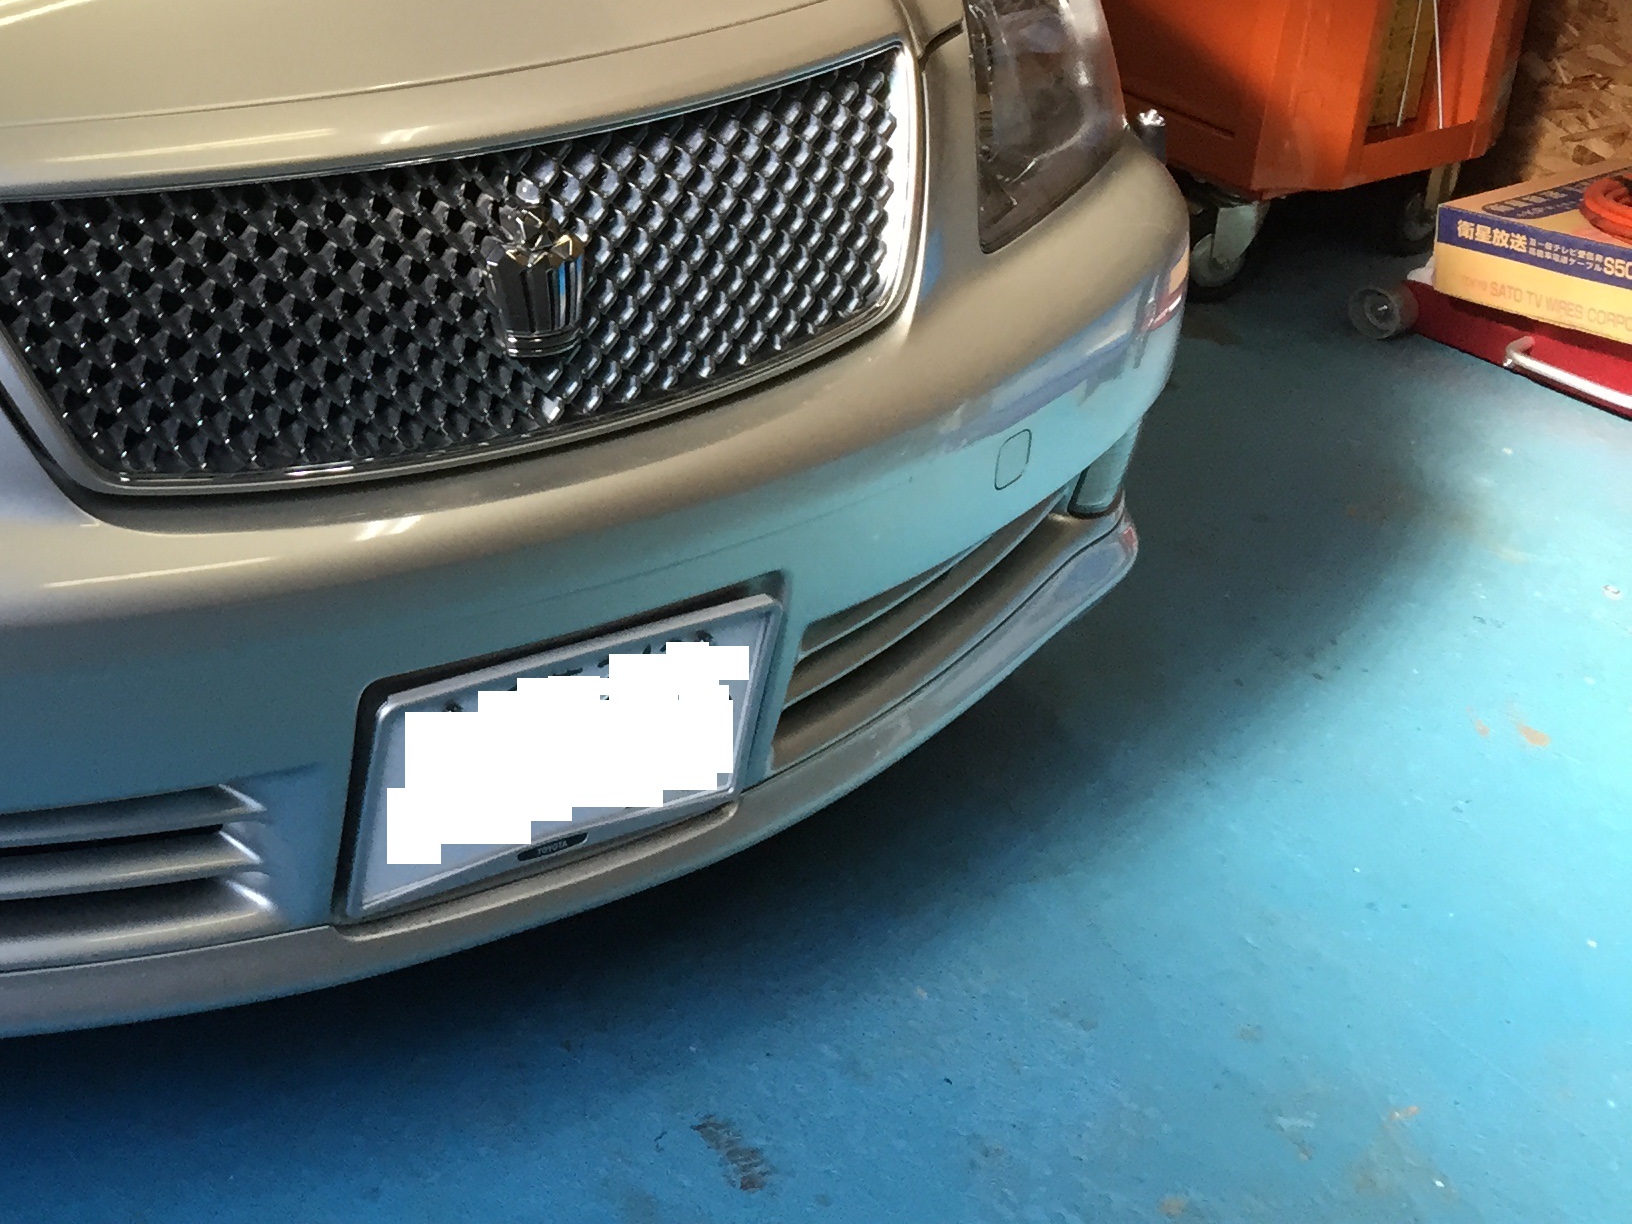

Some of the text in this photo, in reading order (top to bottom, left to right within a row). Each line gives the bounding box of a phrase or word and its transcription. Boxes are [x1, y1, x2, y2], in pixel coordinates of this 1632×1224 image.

[1457, 219, 1528, 253] 衛星放送
[1490, 281, 1524, 303] SATO
[1525, 290, 1544, 308] TV
[1545, 296, 1583, 318] WIRES
[537, 840, 568, 856] TOYOTA
